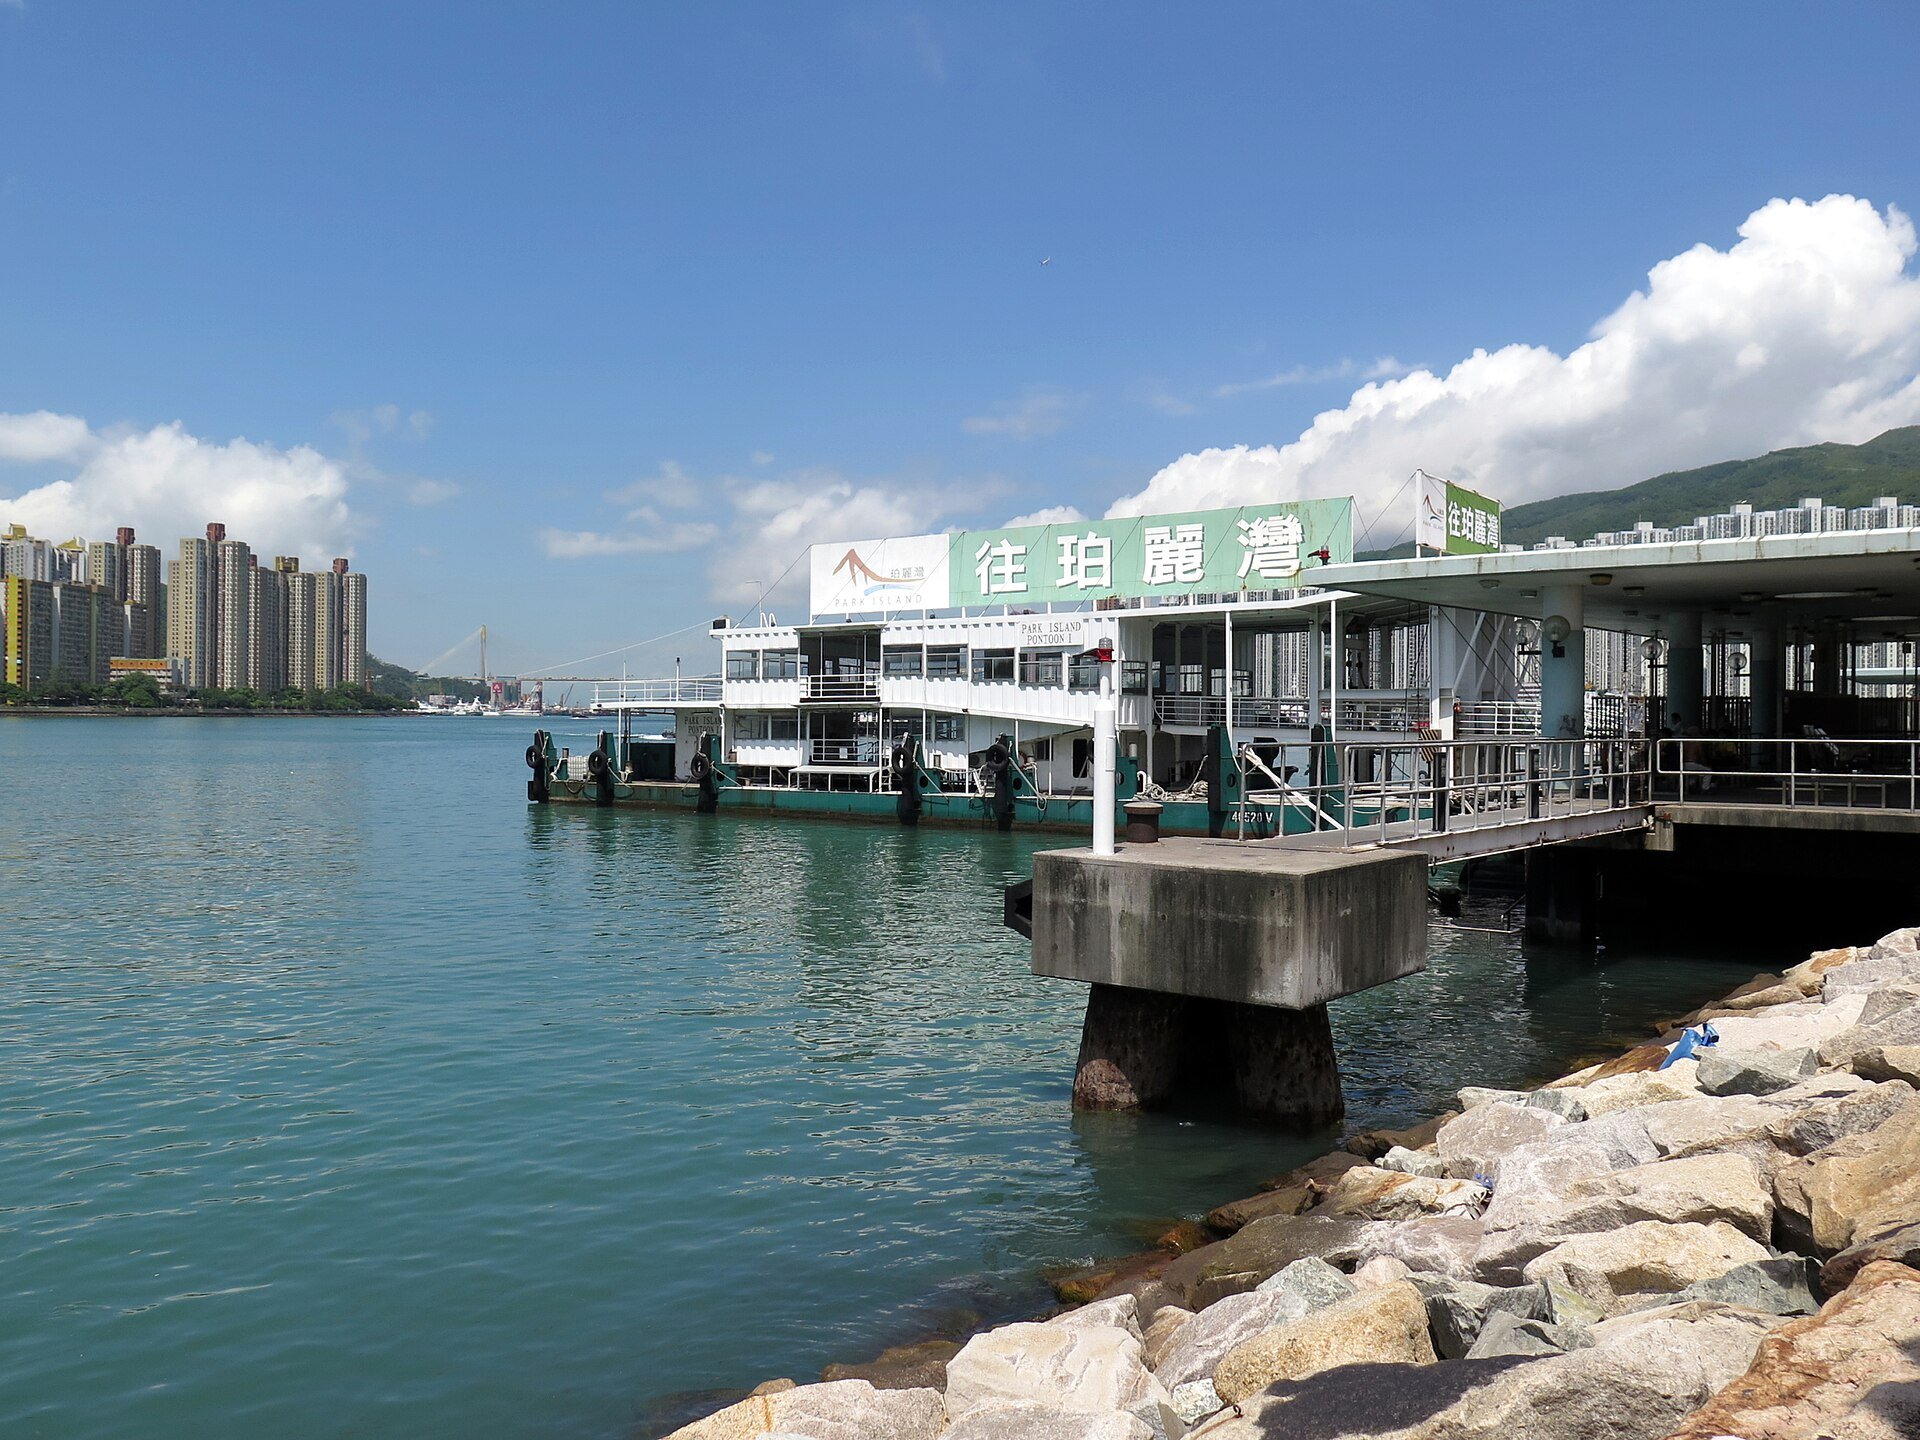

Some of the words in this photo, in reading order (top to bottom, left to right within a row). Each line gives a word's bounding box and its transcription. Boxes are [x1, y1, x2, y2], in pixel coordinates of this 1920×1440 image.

[1448, 500, 1499, 549] 往珀麗灣
[974, 513, 1304, 596] 往珀麗灣
[835, 597, 865, 607] PARK
[872, 594, 922, 605] ISLAND
[1021, 623, 1043, 634] PARK
[1049, 621, 1082, 633] ISLAND
[1027, 633, 1065, 645] PONTOON
[684, 716, 700, 725] PARK
[1265, 811, 1273, 823] V
